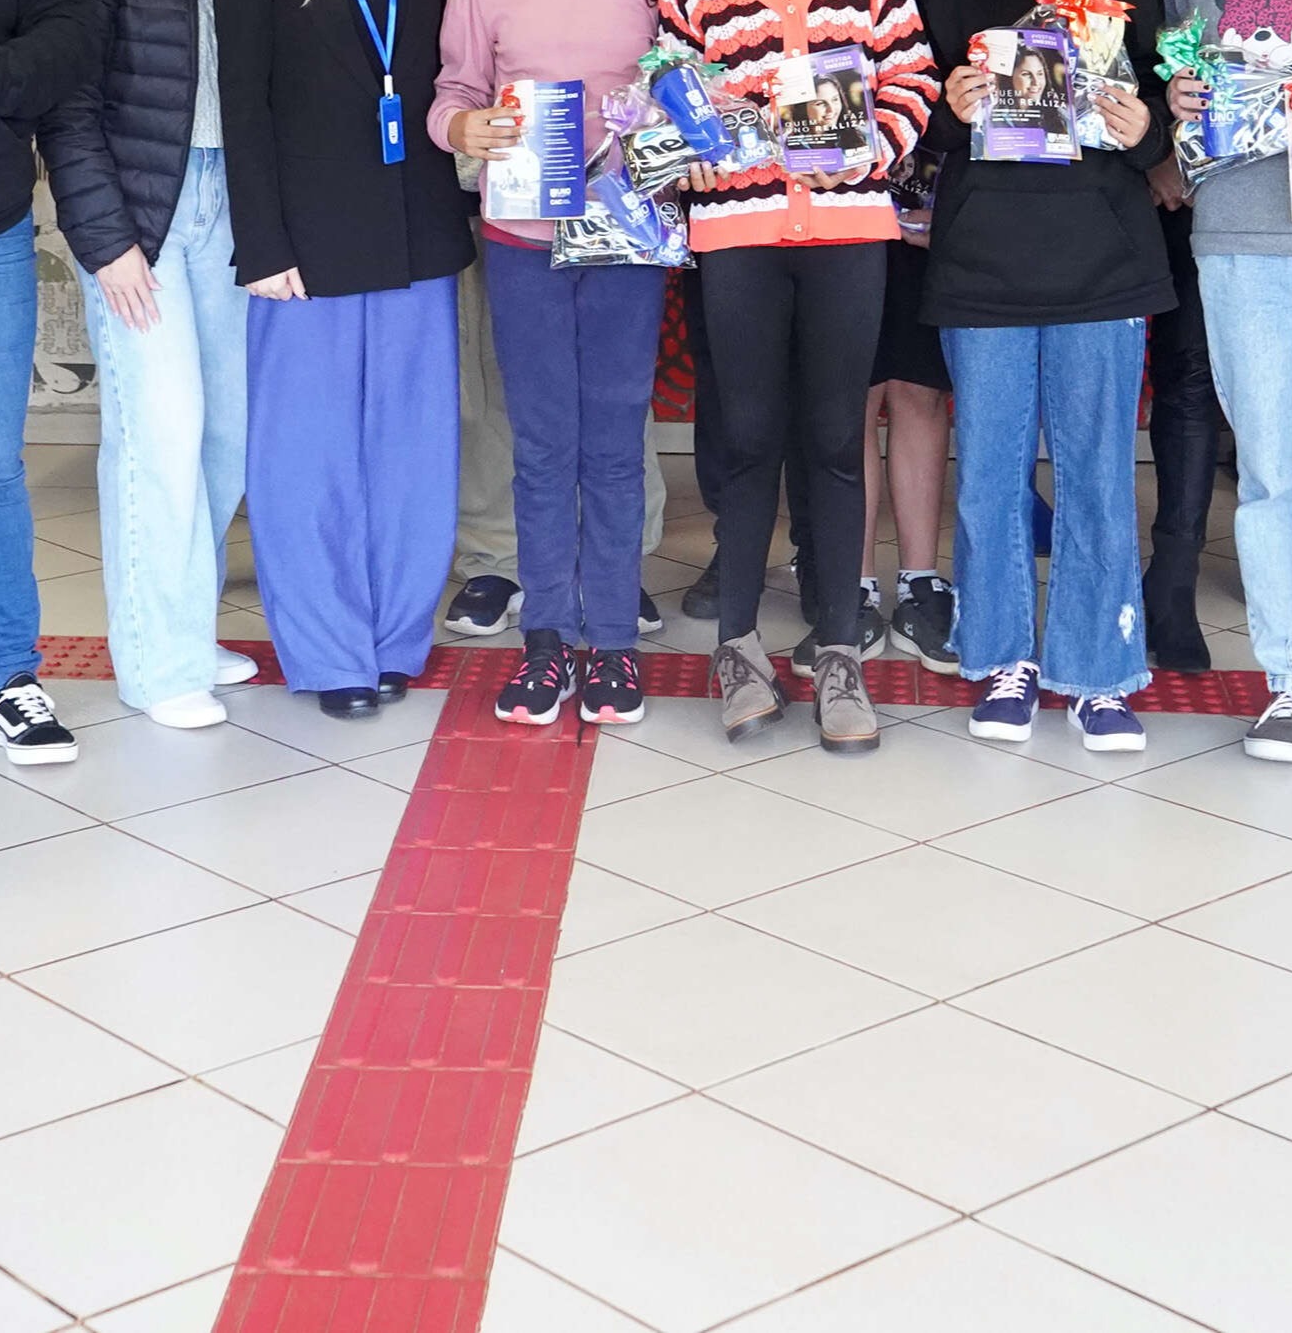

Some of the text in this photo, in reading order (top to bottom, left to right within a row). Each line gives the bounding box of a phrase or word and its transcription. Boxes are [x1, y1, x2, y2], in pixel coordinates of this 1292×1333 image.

[1046, 91, 1066, 101] FAZ
[1020, 98, 1067, 108] REALIZA
[843, 111, 865, 121] FAZ
[1209, 111, 1235, 123] UNO
[815, 120, 866, 132] REALIZA
